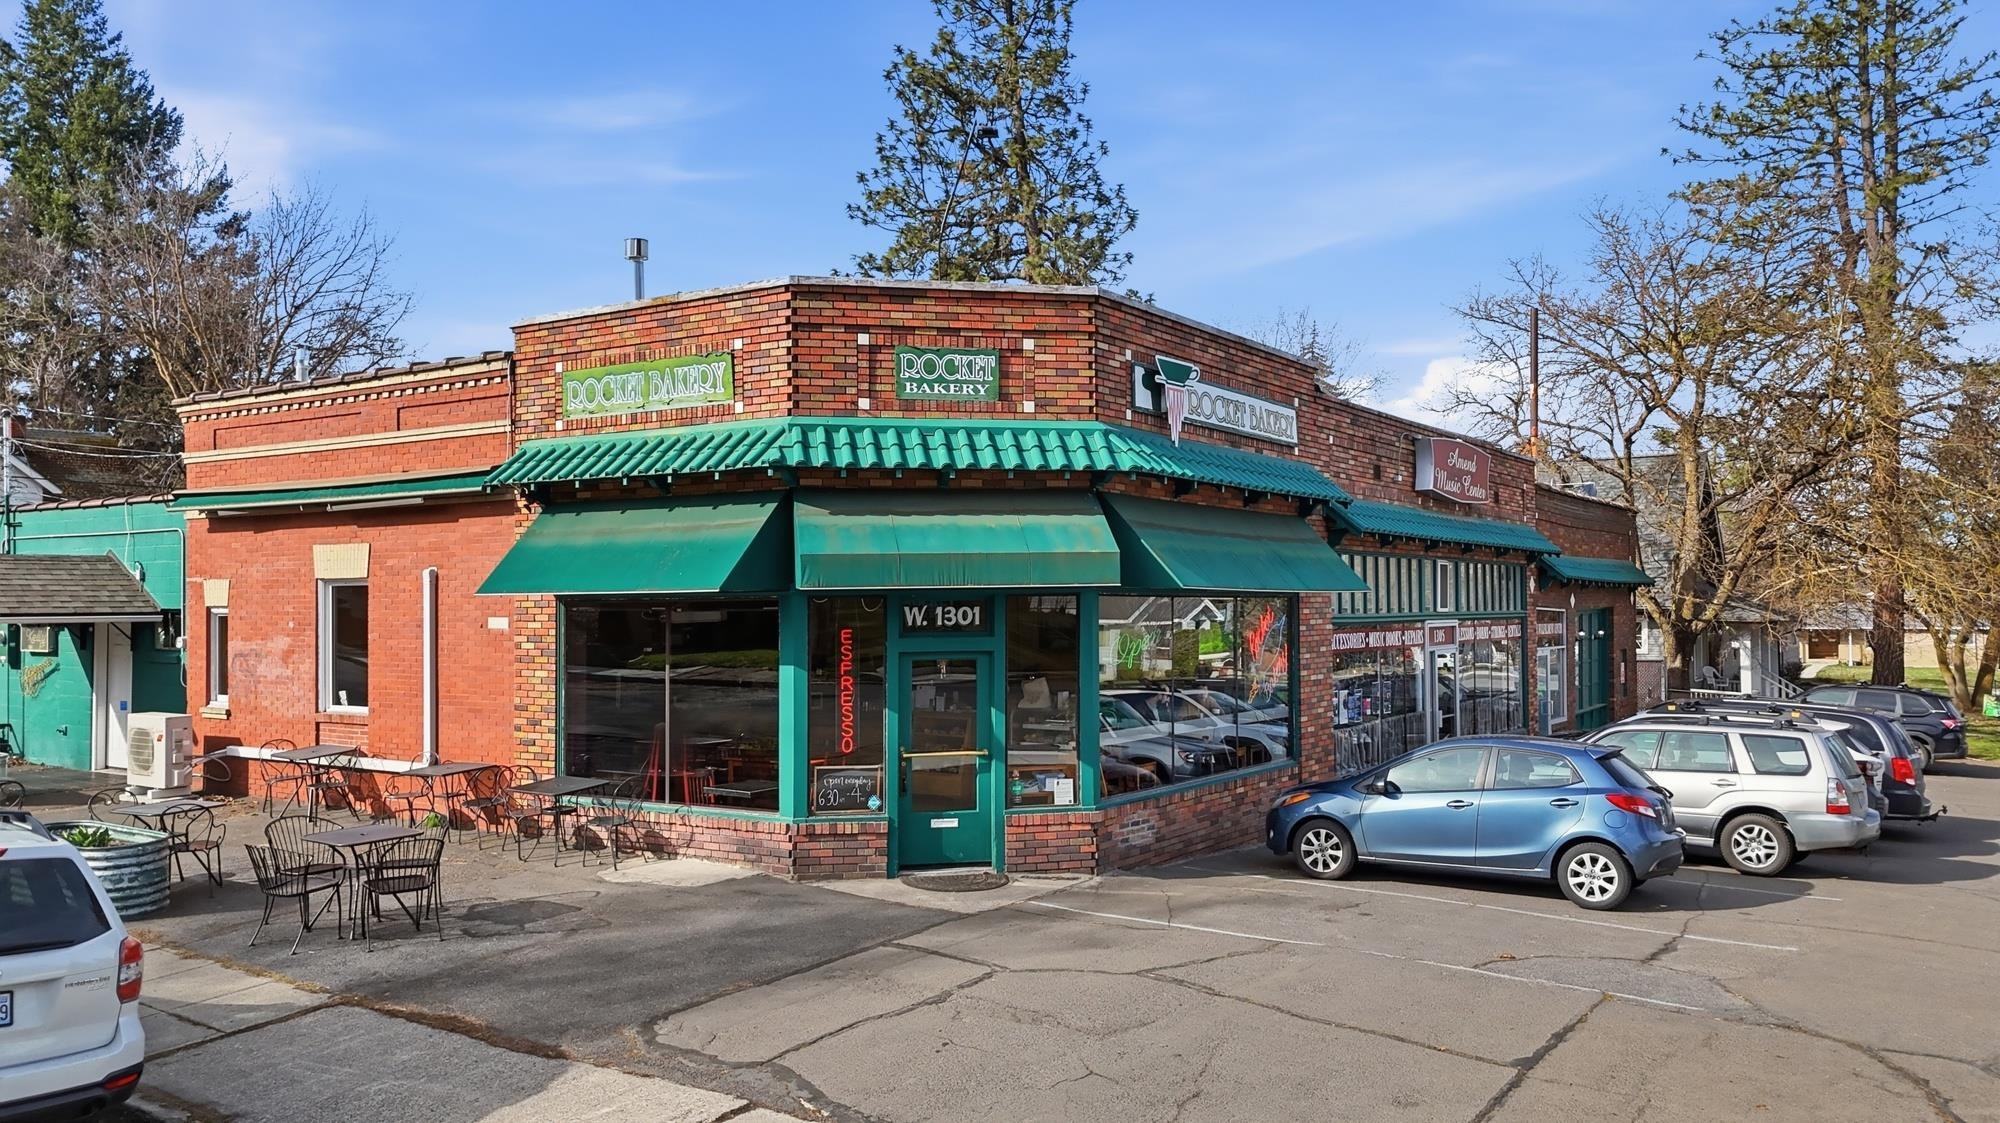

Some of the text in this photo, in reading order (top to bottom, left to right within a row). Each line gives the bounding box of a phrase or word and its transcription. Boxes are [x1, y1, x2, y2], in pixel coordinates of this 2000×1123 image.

[900, 353, 995, 381] ROCKET
[567, 362, 726, 409] ROCKET BAKERY
[904, 382, 990, 395] BAKERY
[1187, 388, 1294, 439] ROCKET BAKERY
[1447, 448, 1477, 472] Amend
[1435, 468, 1486, 499] Music Center
[904, 606, 981, 627] W. 1301
[1368, 631, 1385, 647] MUSIC
[1385, 630, 1402, 646] BOOKS
[1404, 629, 1424, 645] REPAIRS
[840, 629, 853, 753] ESPRESSO
